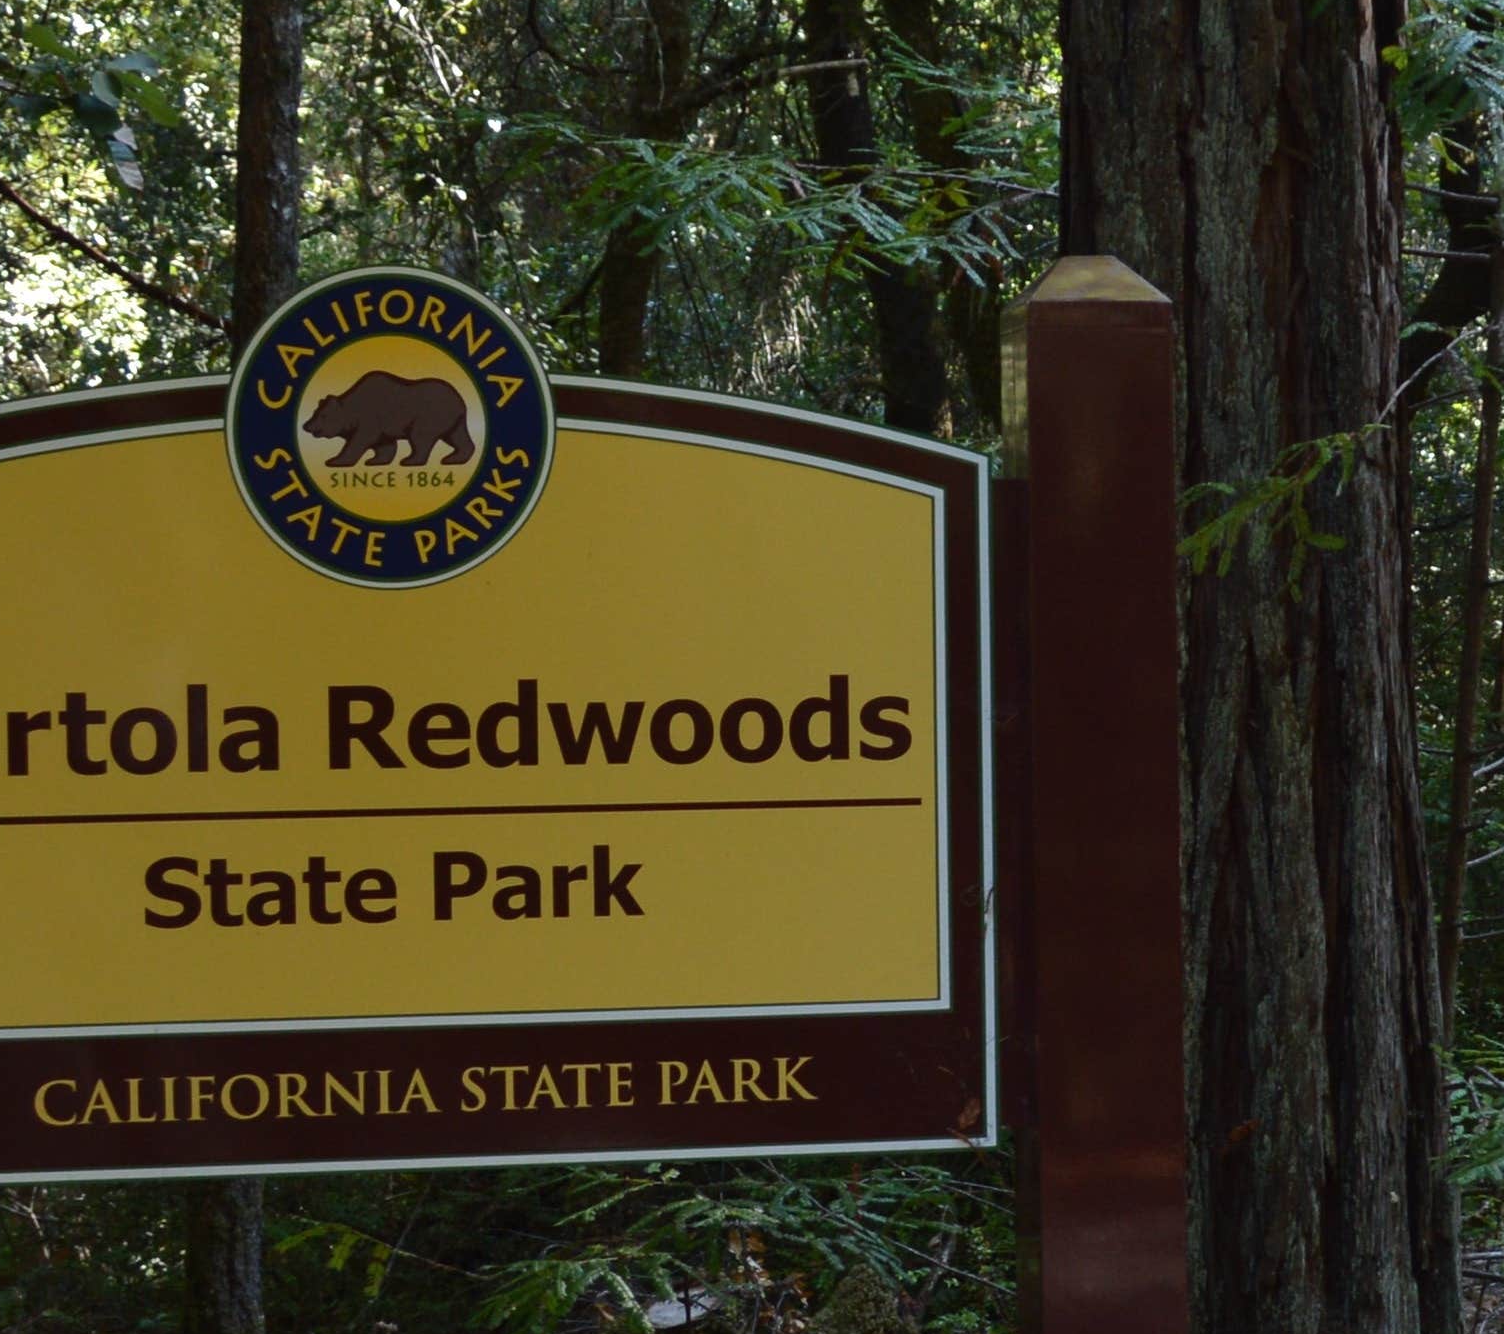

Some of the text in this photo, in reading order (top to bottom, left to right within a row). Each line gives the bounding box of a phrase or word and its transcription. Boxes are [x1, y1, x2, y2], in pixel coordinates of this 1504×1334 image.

[257, 289, 524, 409] CALIFORNIA
[254, 446, 530, 567] STATE PARKS
[330, 470, 456, 488] SINCE 1864
[327, 674, 913, 771] Redwoods
[144, 844, 645, 930] State Park
[33, 1055, 819, 1126] CALIFORNIA STATE PARK
